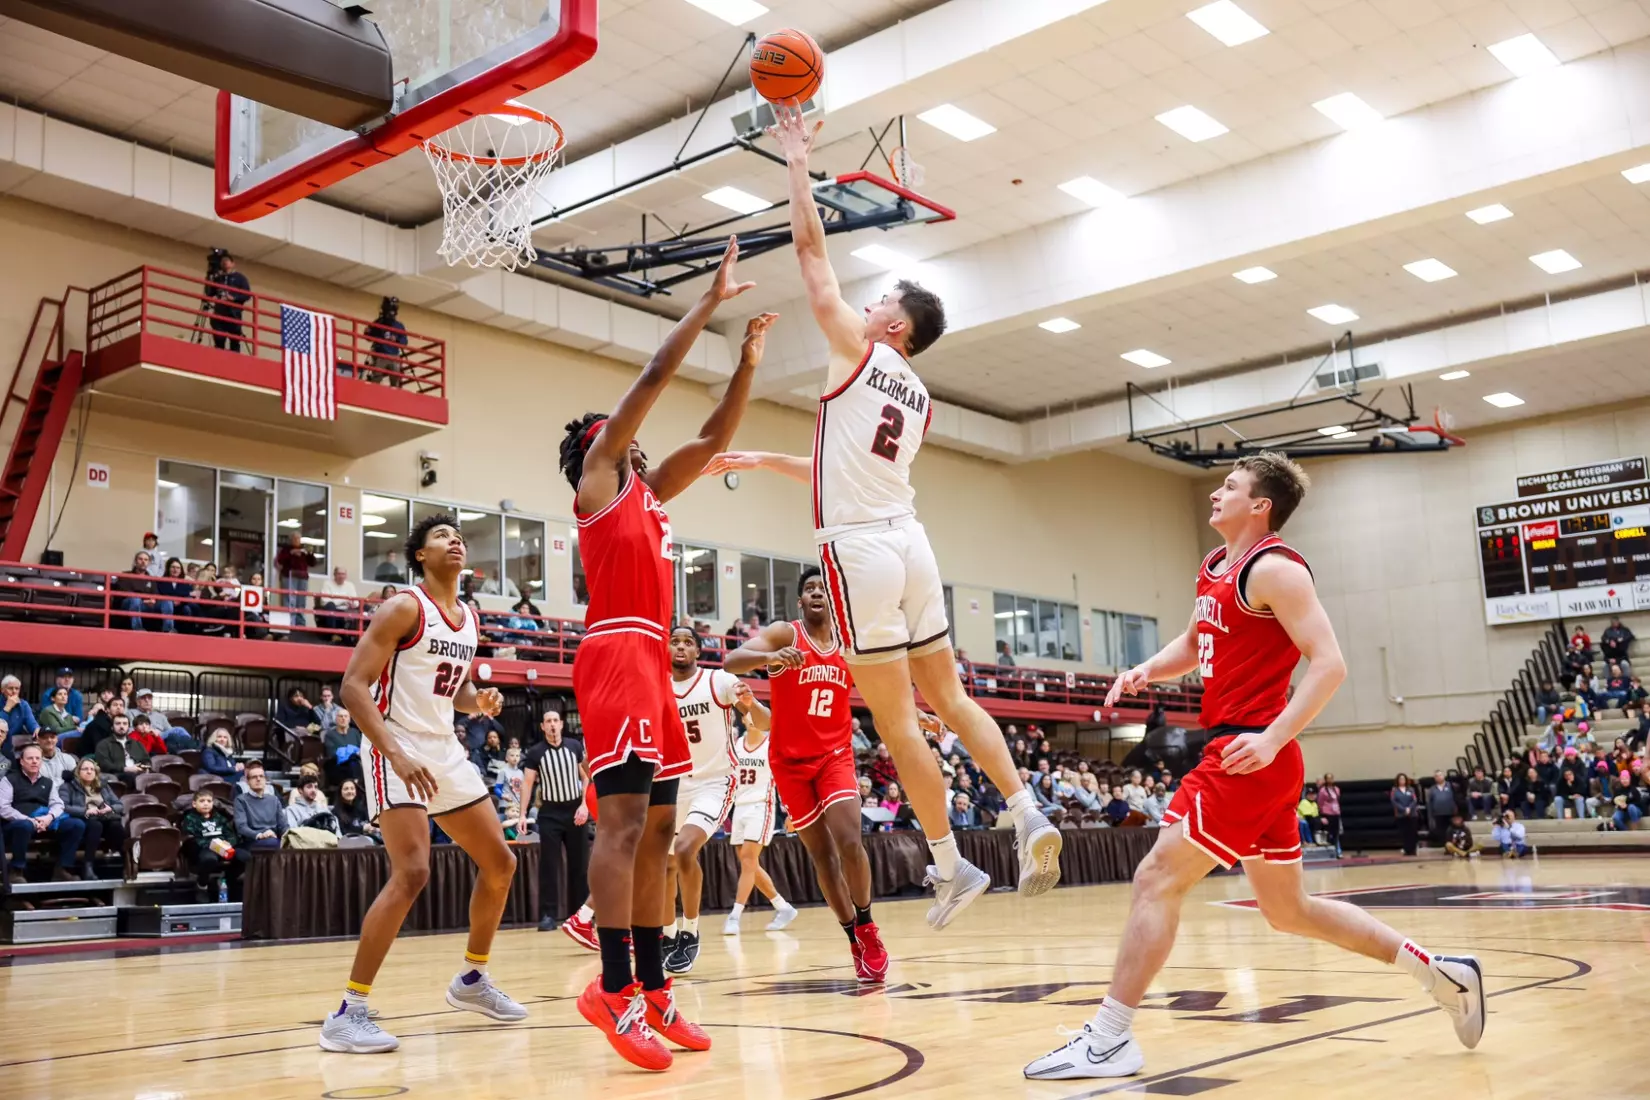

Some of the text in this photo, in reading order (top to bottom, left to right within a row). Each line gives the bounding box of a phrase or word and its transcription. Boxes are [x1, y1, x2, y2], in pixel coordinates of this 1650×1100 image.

[866, 366, 926, 415] KLOMAN
[871, 403, 905, 463] 2
[89, 468, 108, 482] DD
[1518, 473, 1560, 487] RICHARD
[1561, 471, 1572, 481] A.
[1574, 463, 1624, 479] FRIEDMAN
[1546, 474, 1611, 492] SCOREBOARD
[339, 506, 353, 519] EE
[1497, 486, 1650, 520] BROWN UNIVERSI
[245, 590, 260, 607] D
[427, 638, 476, 662] BROWN
[433, 662, 463, 698] 22
[798, 664, 848, 690] CORNELL
[678, 702, 710, 719] OWN
[807, 688, 834, 718] 12
[639, 719, 652, 744] C
[738, 758, 765, 767] ROWN
[739, 769, 756, 785] 23
